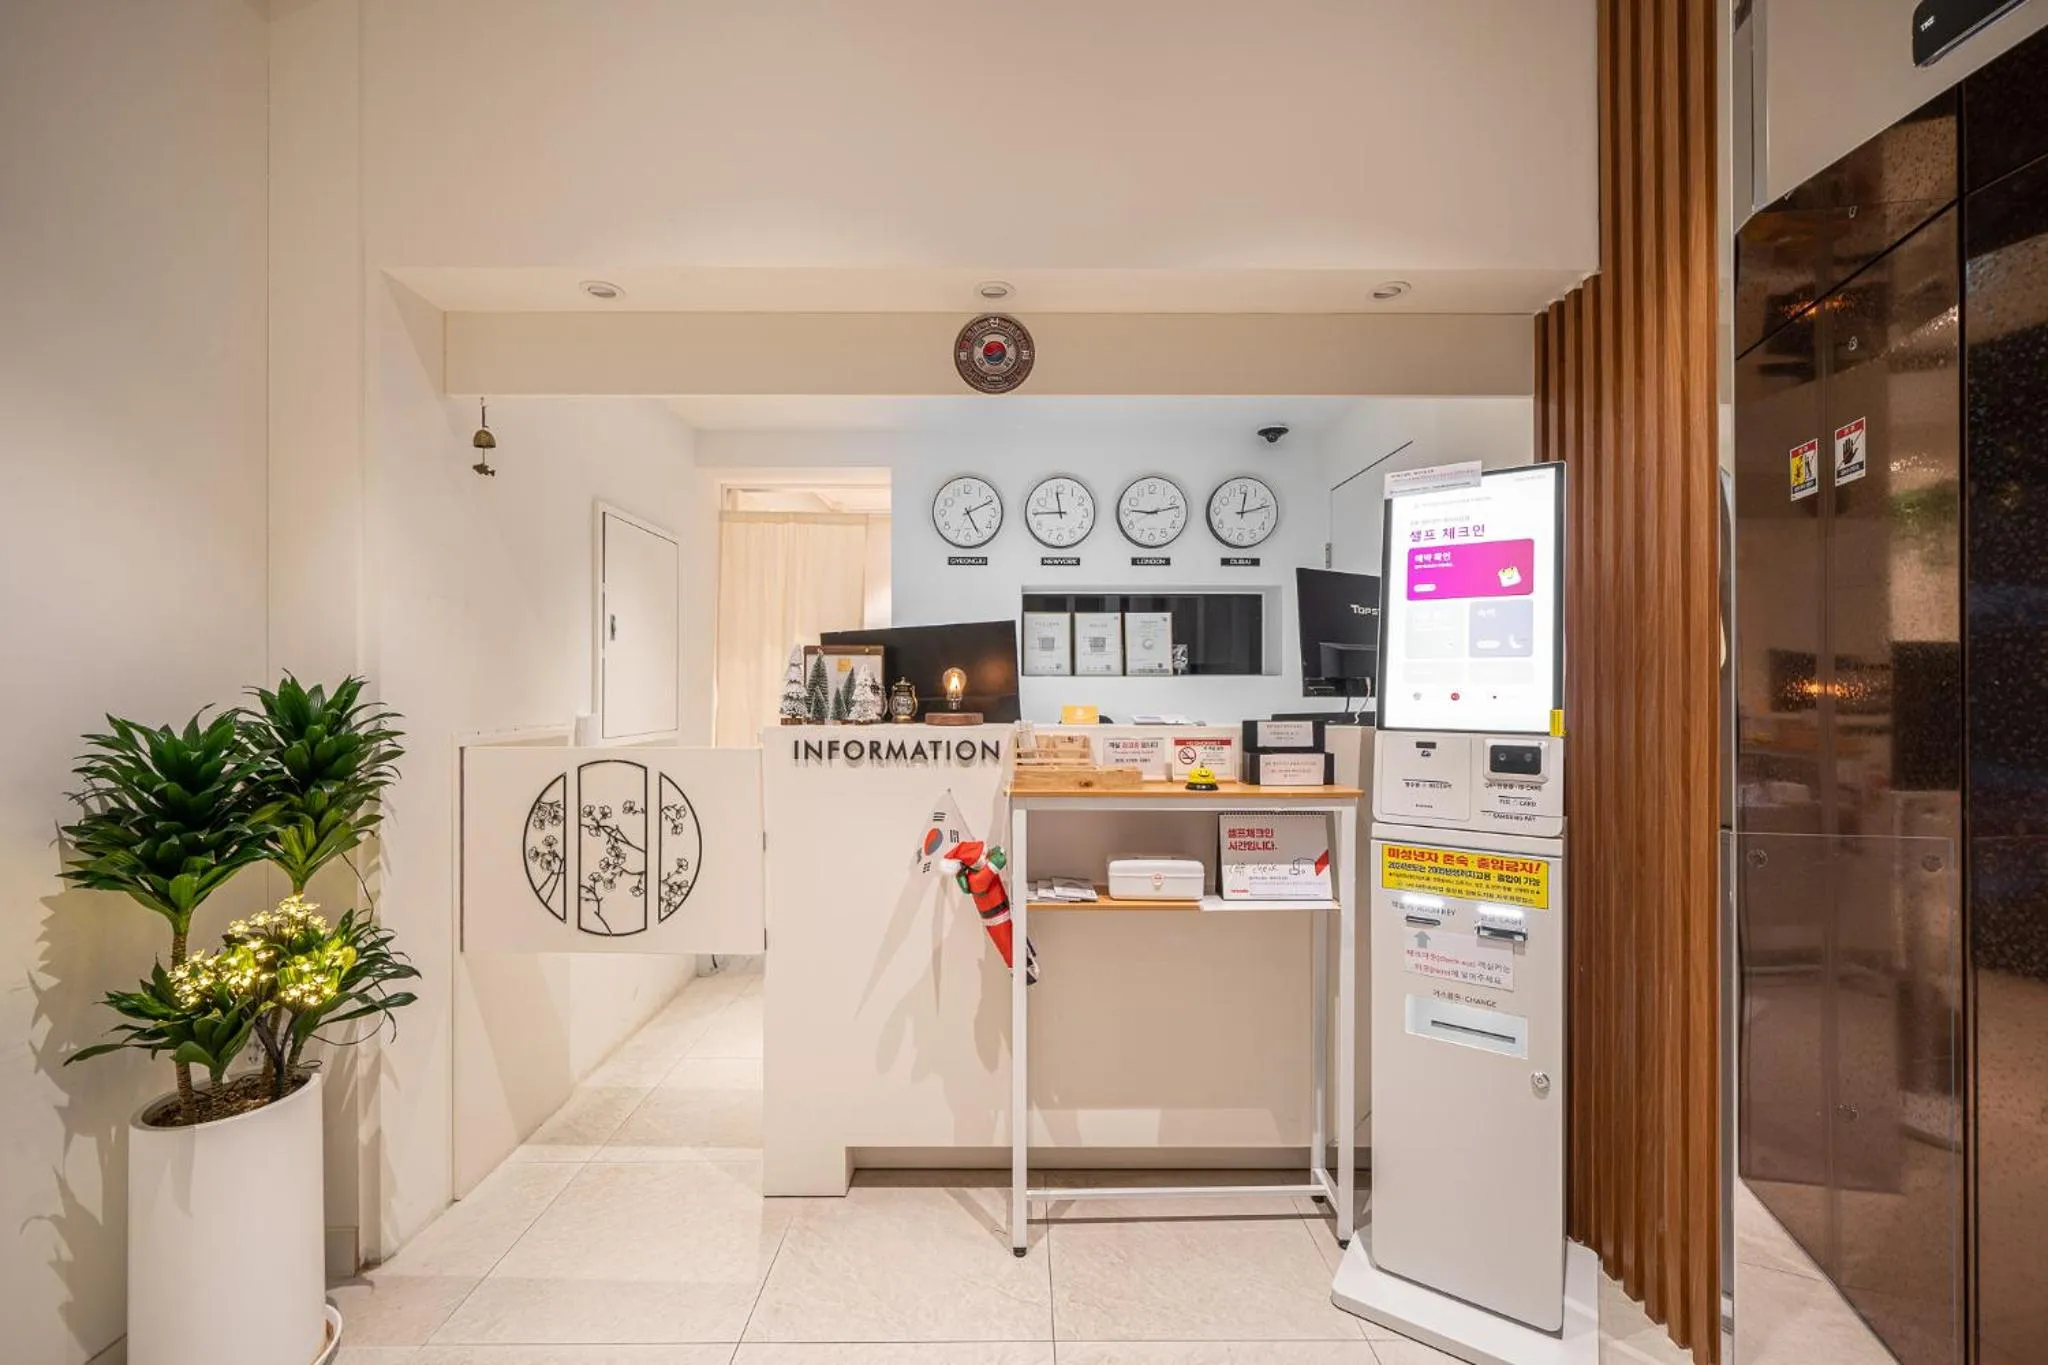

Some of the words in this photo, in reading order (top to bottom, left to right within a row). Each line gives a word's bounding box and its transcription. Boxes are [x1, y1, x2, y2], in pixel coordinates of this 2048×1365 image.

[1410, 529, 1437, 542] 셀프
[1443, 523, 1485, 540] 체크인
[793, 740, 1000, 761] INFORMATION
[1228, 828, 1274, 838] 셀프체크인
[1228, 840, 1279, 851] 시간입니다.
[1388, 848, 1438, 863] 미성년자
[1443, 854, 1469, 866] 혼숙
[1477, 858, 1541, 874] 출입금지!
